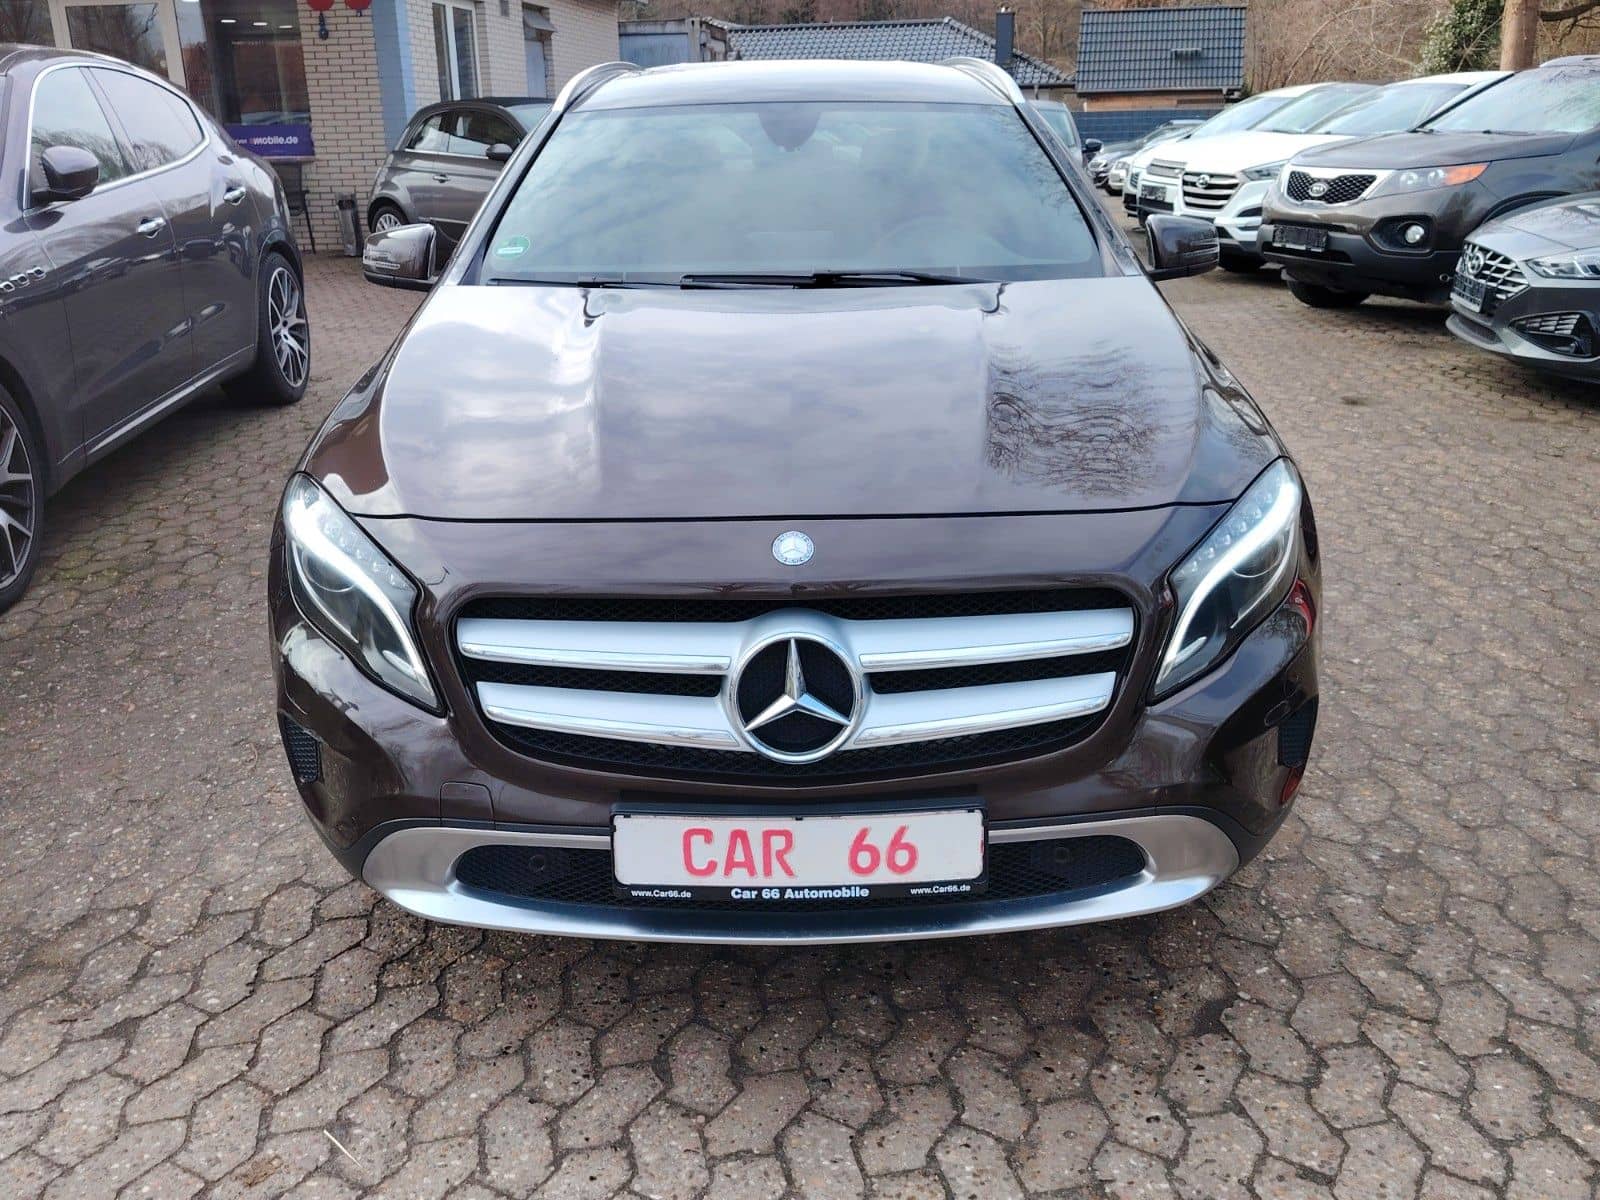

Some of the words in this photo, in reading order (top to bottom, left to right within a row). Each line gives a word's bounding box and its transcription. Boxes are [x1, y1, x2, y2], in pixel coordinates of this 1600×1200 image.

[252, 135, 299, 146] mobile.de
[682, 827, 797, 878] CAR
[847, 824, 920, 877] 66
[631, 889, 692, 899] www.Car66.de
[730, 887, 758, 899] Car
[761, 887, 780, 899] 66
[784, 886, 870, 899] Automobile
[910, 884, 971, 895] www.Car66.de
